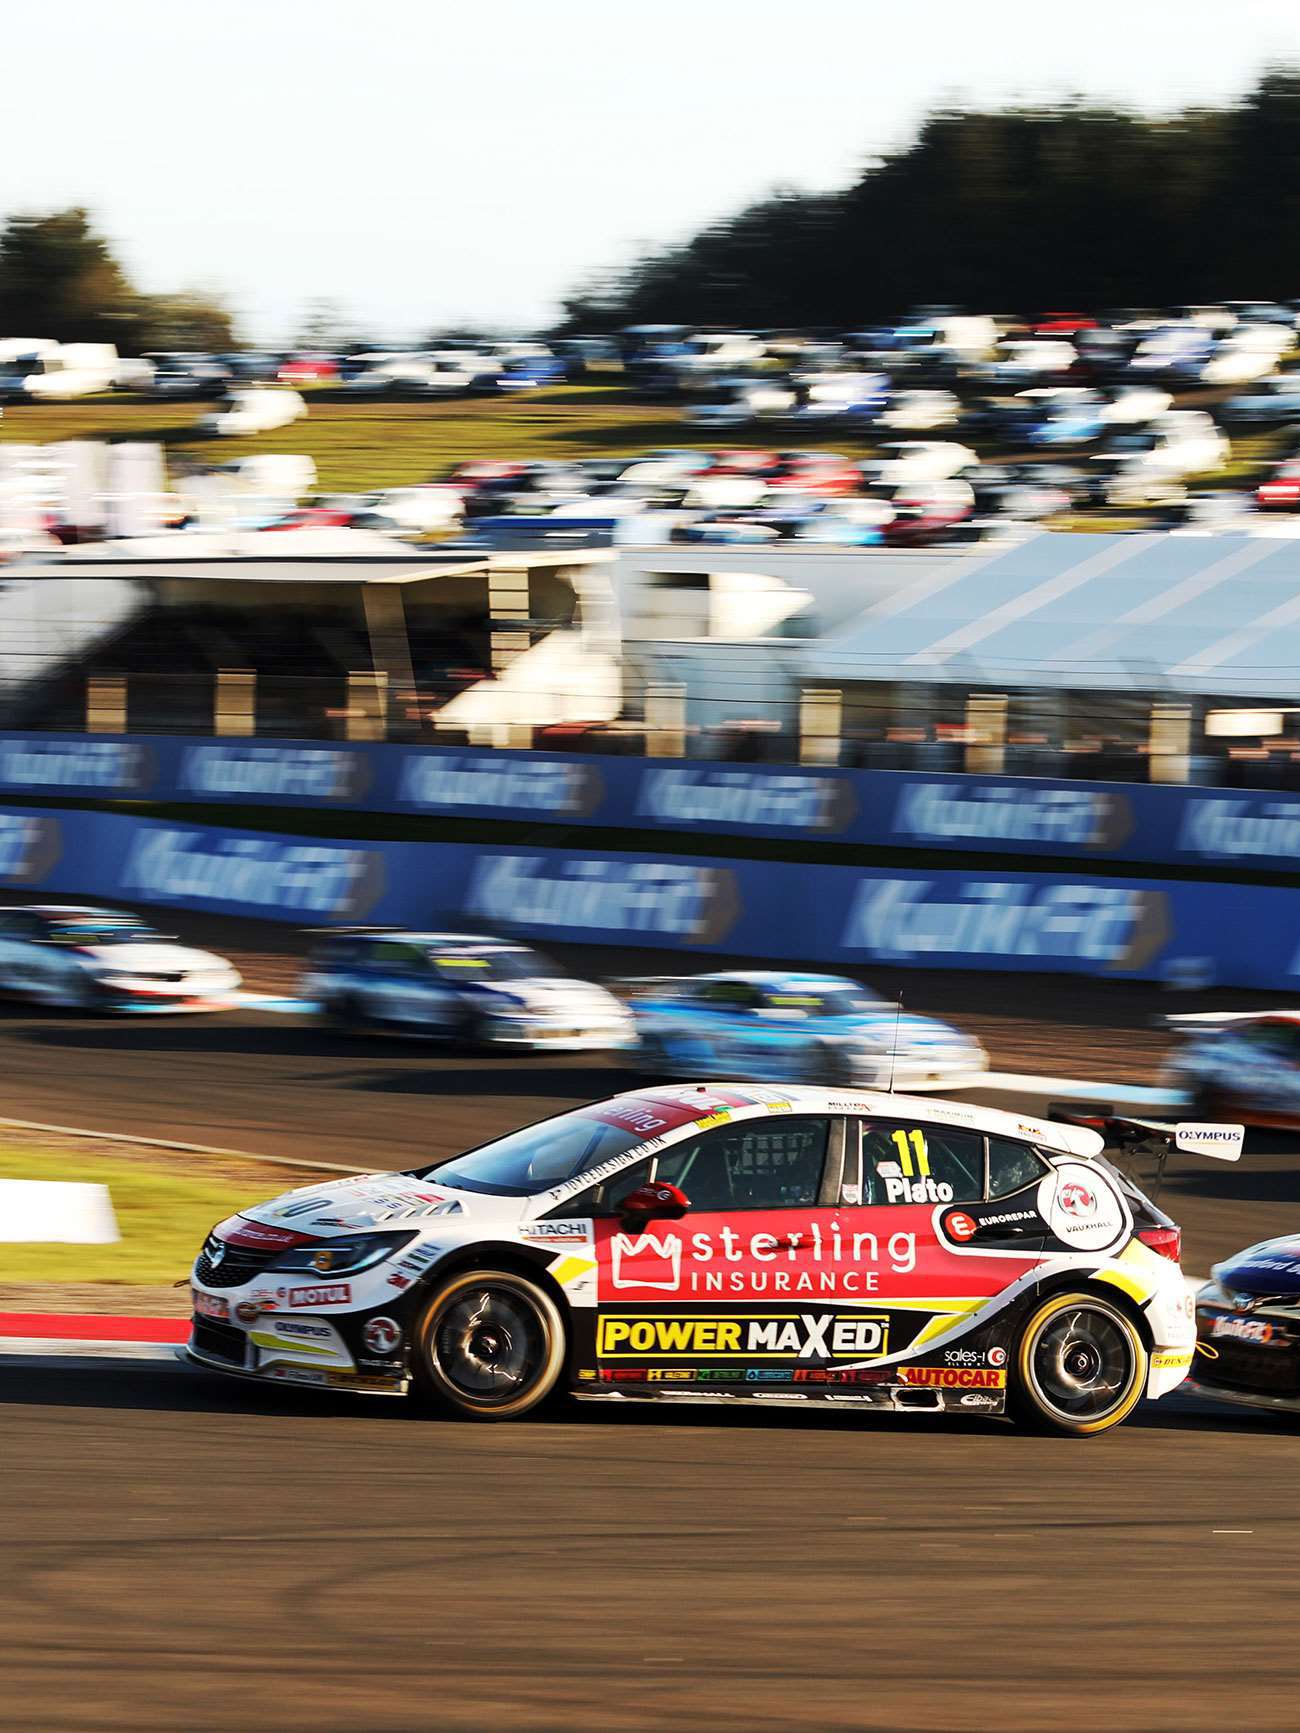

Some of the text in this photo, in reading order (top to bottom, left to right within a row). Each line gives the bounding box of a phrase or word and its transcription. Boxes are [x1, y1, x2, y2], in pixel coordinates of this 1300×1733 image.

[1178, 1131, 1241, 1141] OLYMPUS
[892, 1129, 930, 1177] 11
[885, 1176, 954, 1203] Plato
[979, 1210, 1037, 1227] EUROREPAR
[1066, 1220, 1113, 1233] VAUXHALL
[691, 1222, 916, 1272] sterling
[691, 1271, 880, 1291] INSURANCE
[294, 1287, 345, 1304] MOTUL
[274, 1321, 333, 1338] OLYMPUS
[603, 1321, 742, 1351] POWER
[905, 1368, 1000, 1387] AUTOCAR
